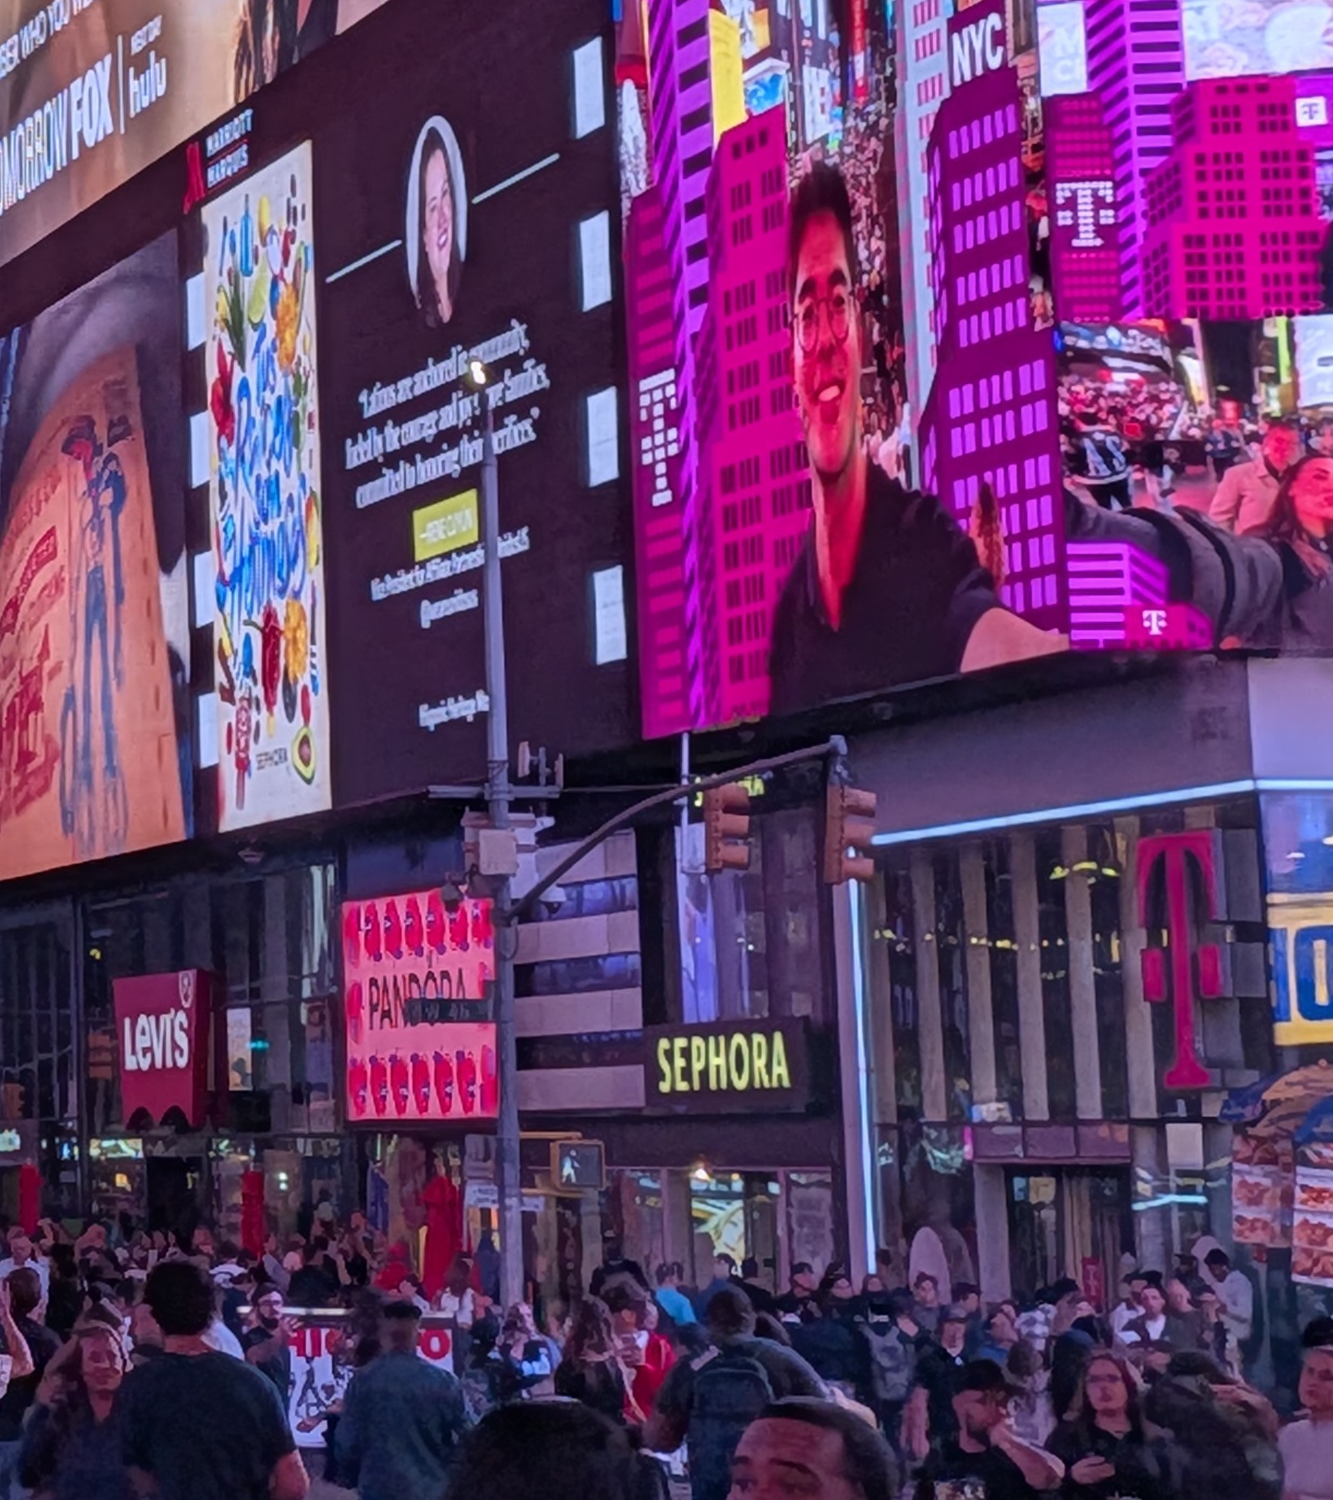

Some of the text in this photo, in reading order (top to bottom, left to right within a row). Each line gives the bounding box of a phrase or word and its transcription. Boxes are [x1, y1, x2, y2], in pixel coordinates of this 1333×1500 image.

[20, 10, 47, 61] WHO
[952, 11, 1004, 86] NYC
[69, 53, 114, 160] FOX
[129, 50, 167, 119] hulu
[1142, 610, 1169, 636] T
[1138, 831, 1222, 1088] T
[657, 1031, 790, 1094] SEPHORA
